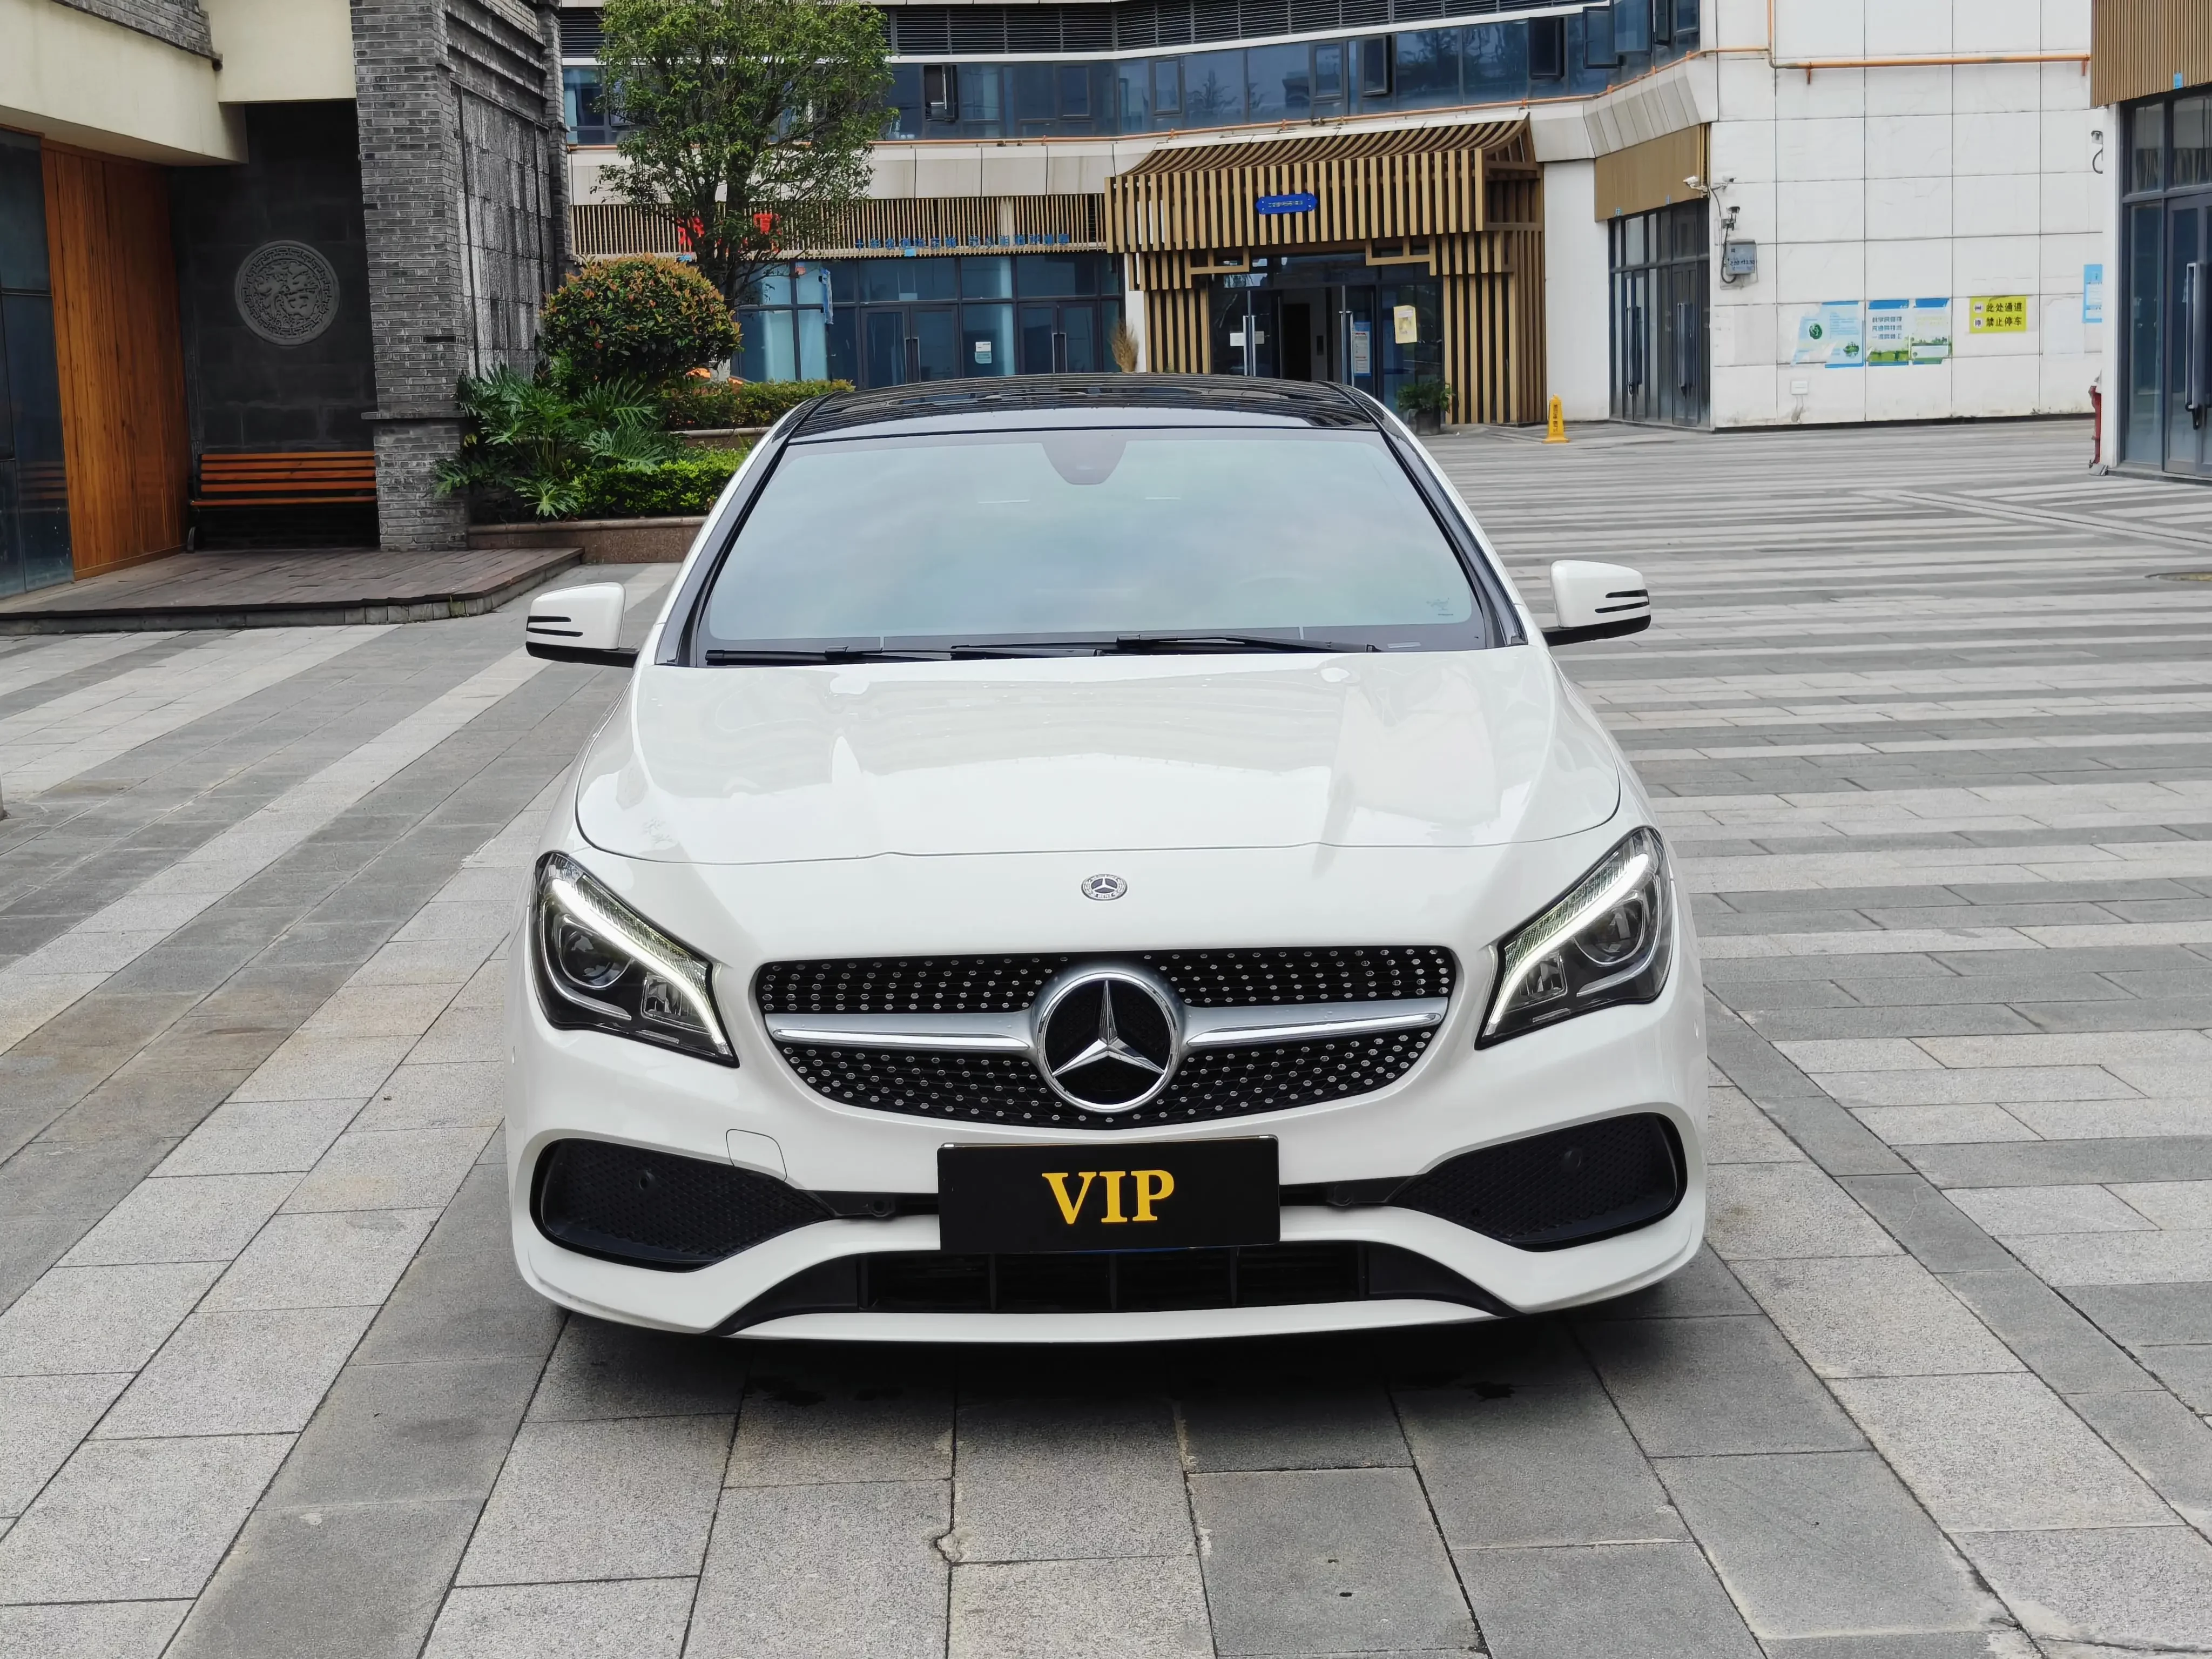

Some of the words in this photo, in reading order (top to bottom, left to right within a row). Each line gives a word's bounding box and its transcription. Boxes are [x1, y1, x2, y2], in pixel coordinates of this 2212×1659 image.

[1986, 302, 2022, 312] 此处通道
[1986, 316, 2022, 327] 禁止停车
[1042, 1169, 1175, 1224] VIP
